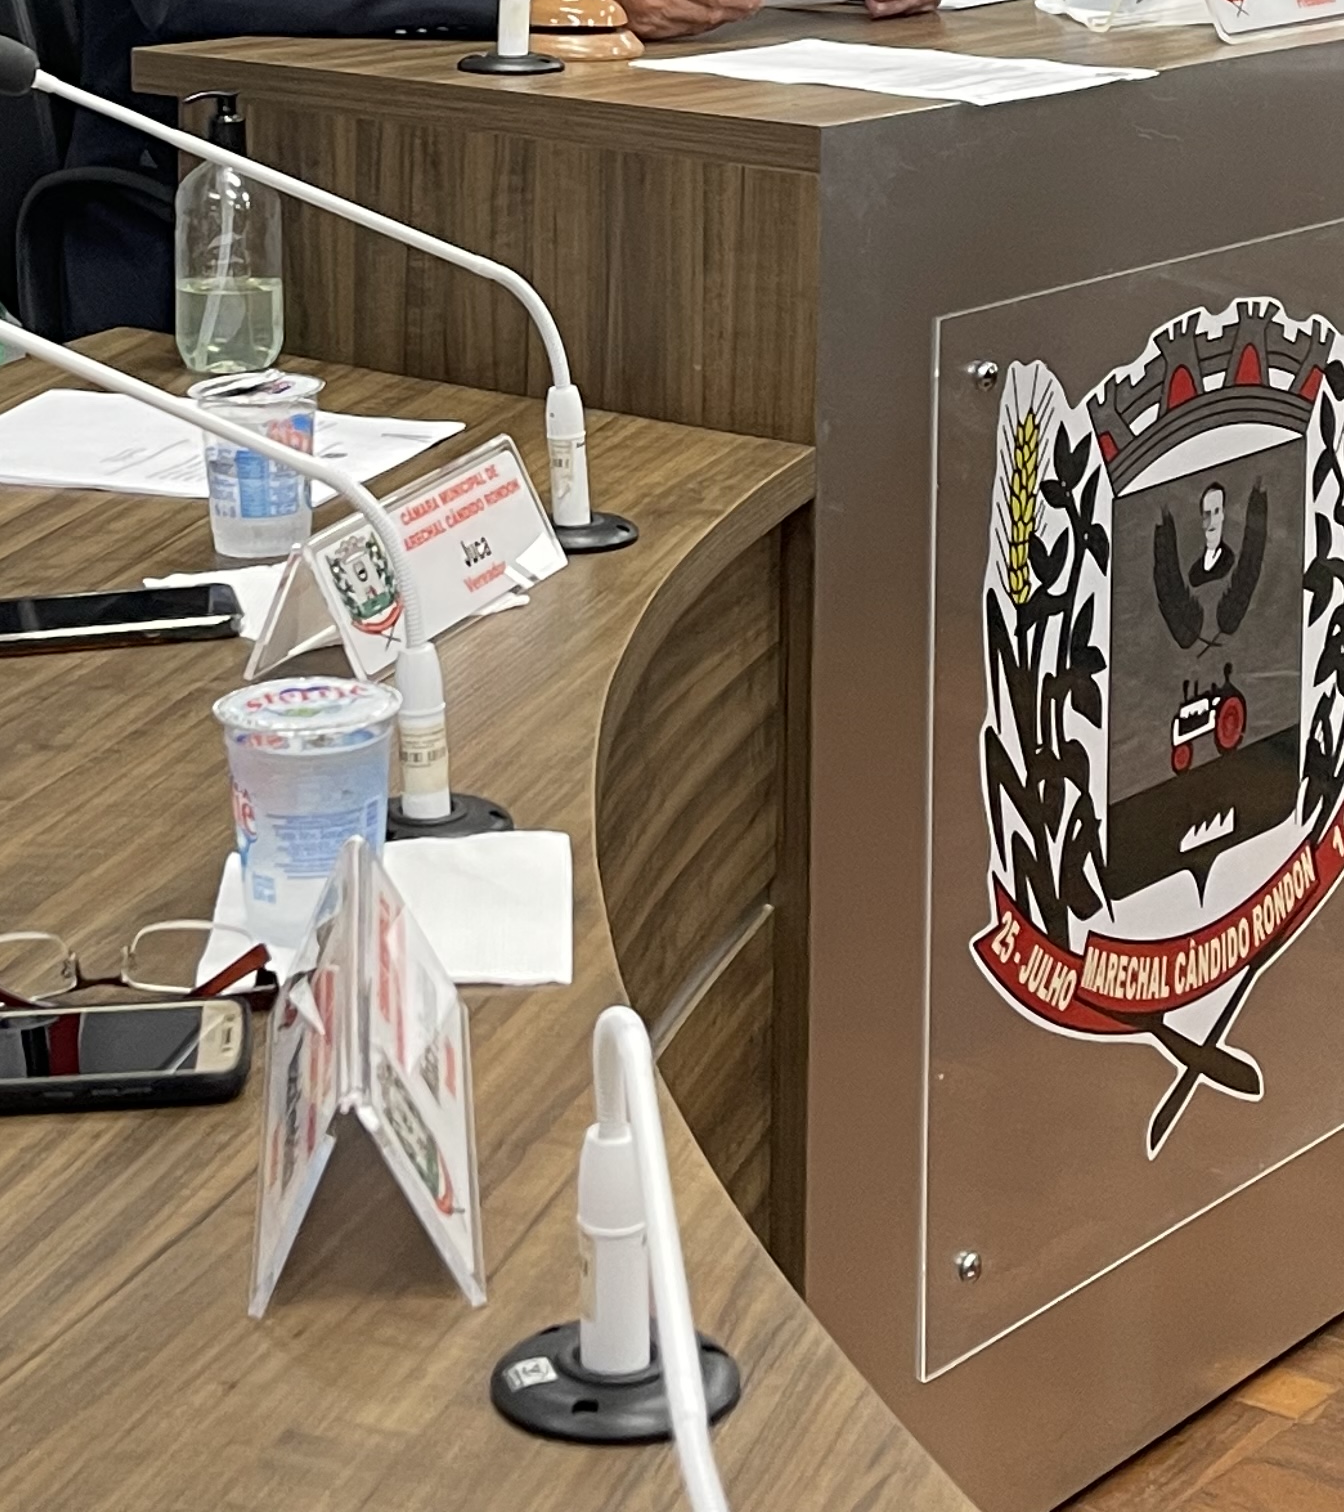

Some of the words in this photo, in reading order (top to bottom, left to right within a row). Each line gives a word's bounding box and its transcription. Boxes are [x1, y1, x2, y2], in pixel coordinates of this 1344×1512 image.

[460, 536, 492, 567] Juca
[991, 911, 1021, 964] 25
[1018, 943, 1078, 1012] JULHO
[1080, 945, 1171, 1001] MARECHAL
[1174, 917, 1250, 995] CÂNDIDO
[1252, 844, 1316, 948] RONDON
